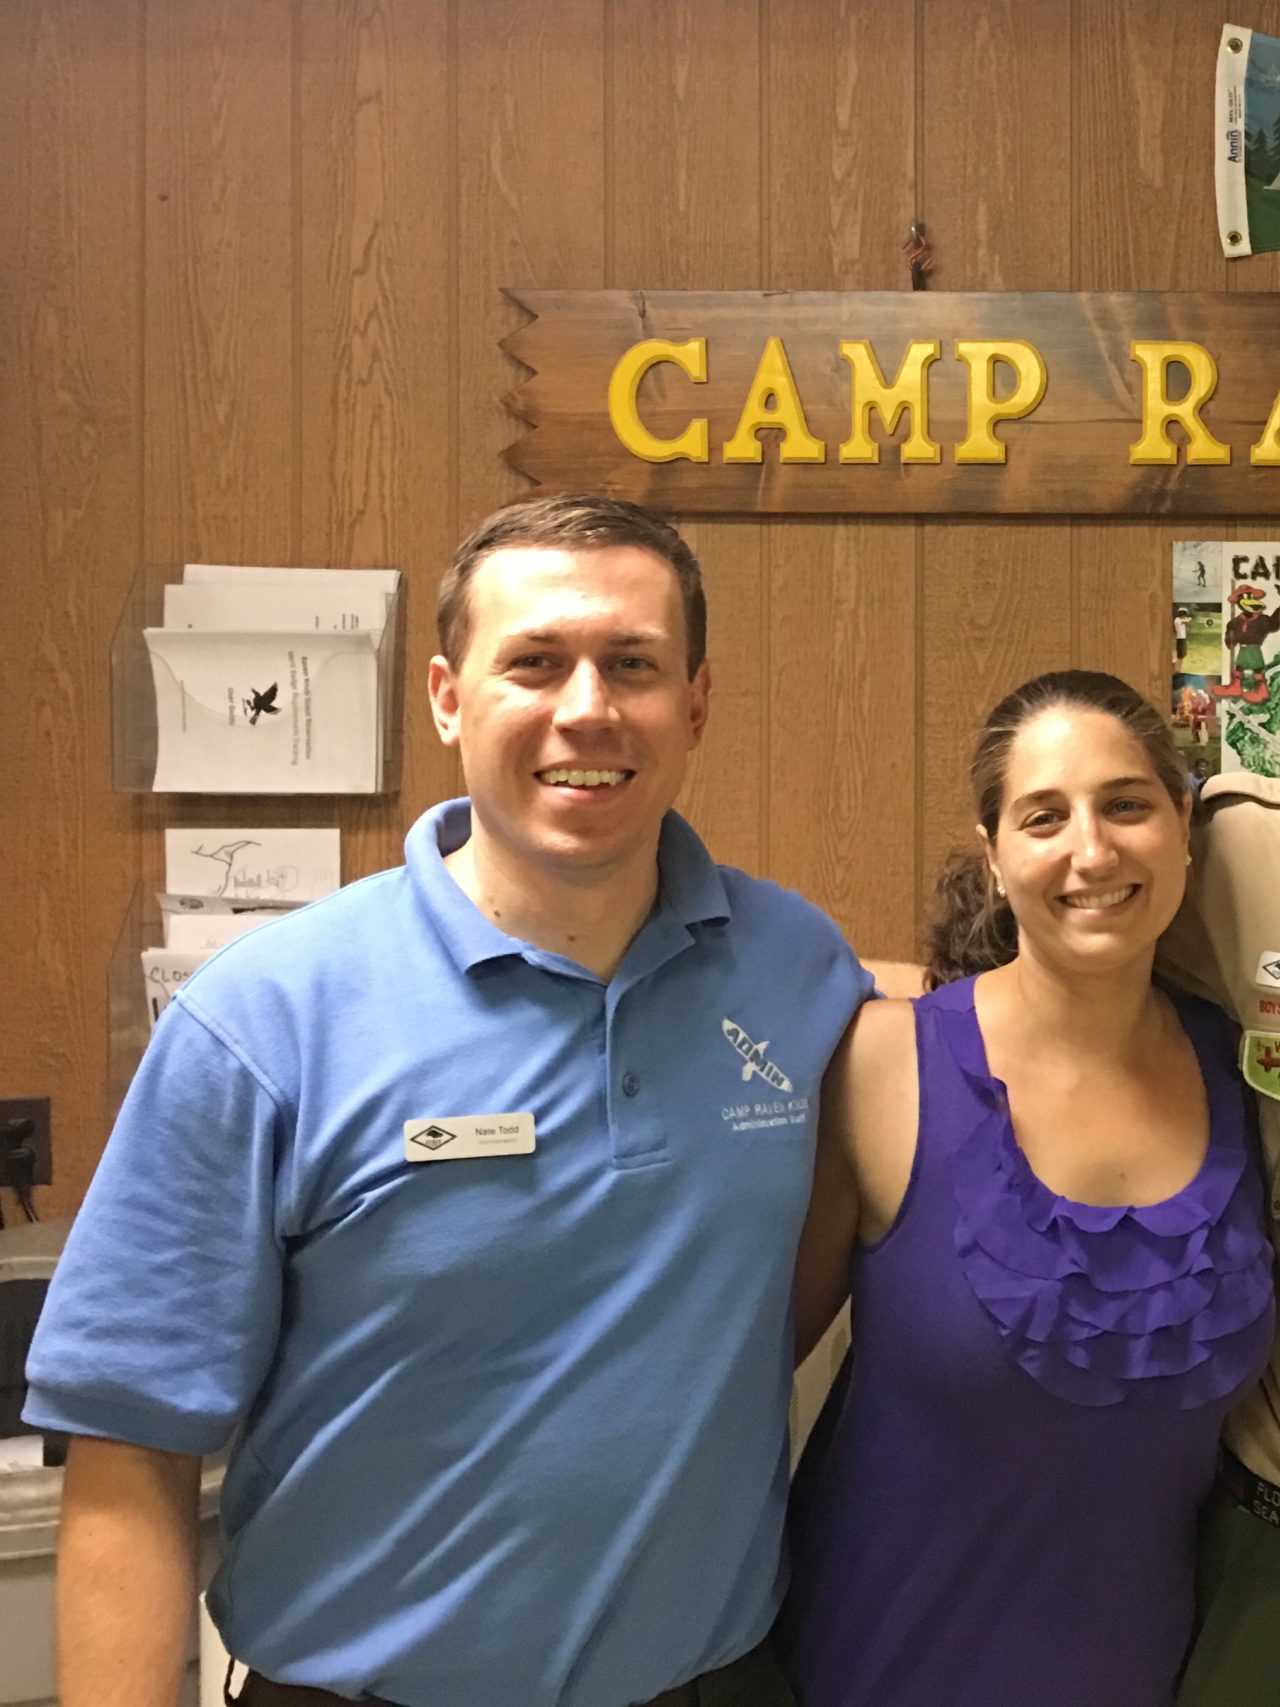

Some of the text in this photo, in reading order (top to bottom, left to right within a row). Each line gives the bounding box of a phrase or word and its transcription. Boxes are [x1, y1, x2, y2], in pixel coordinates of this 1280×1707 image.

[1227, 129, 1240, 162] Annin
[608, 336, 1047, 466] CAMP
[726, 1028, 785, 1088] ADMIN
[721, 1104, 750, 1121] CAMP
[498, 1126, 519, 1134] Todd
[1253, 1500, 1279, 1525] SEA
